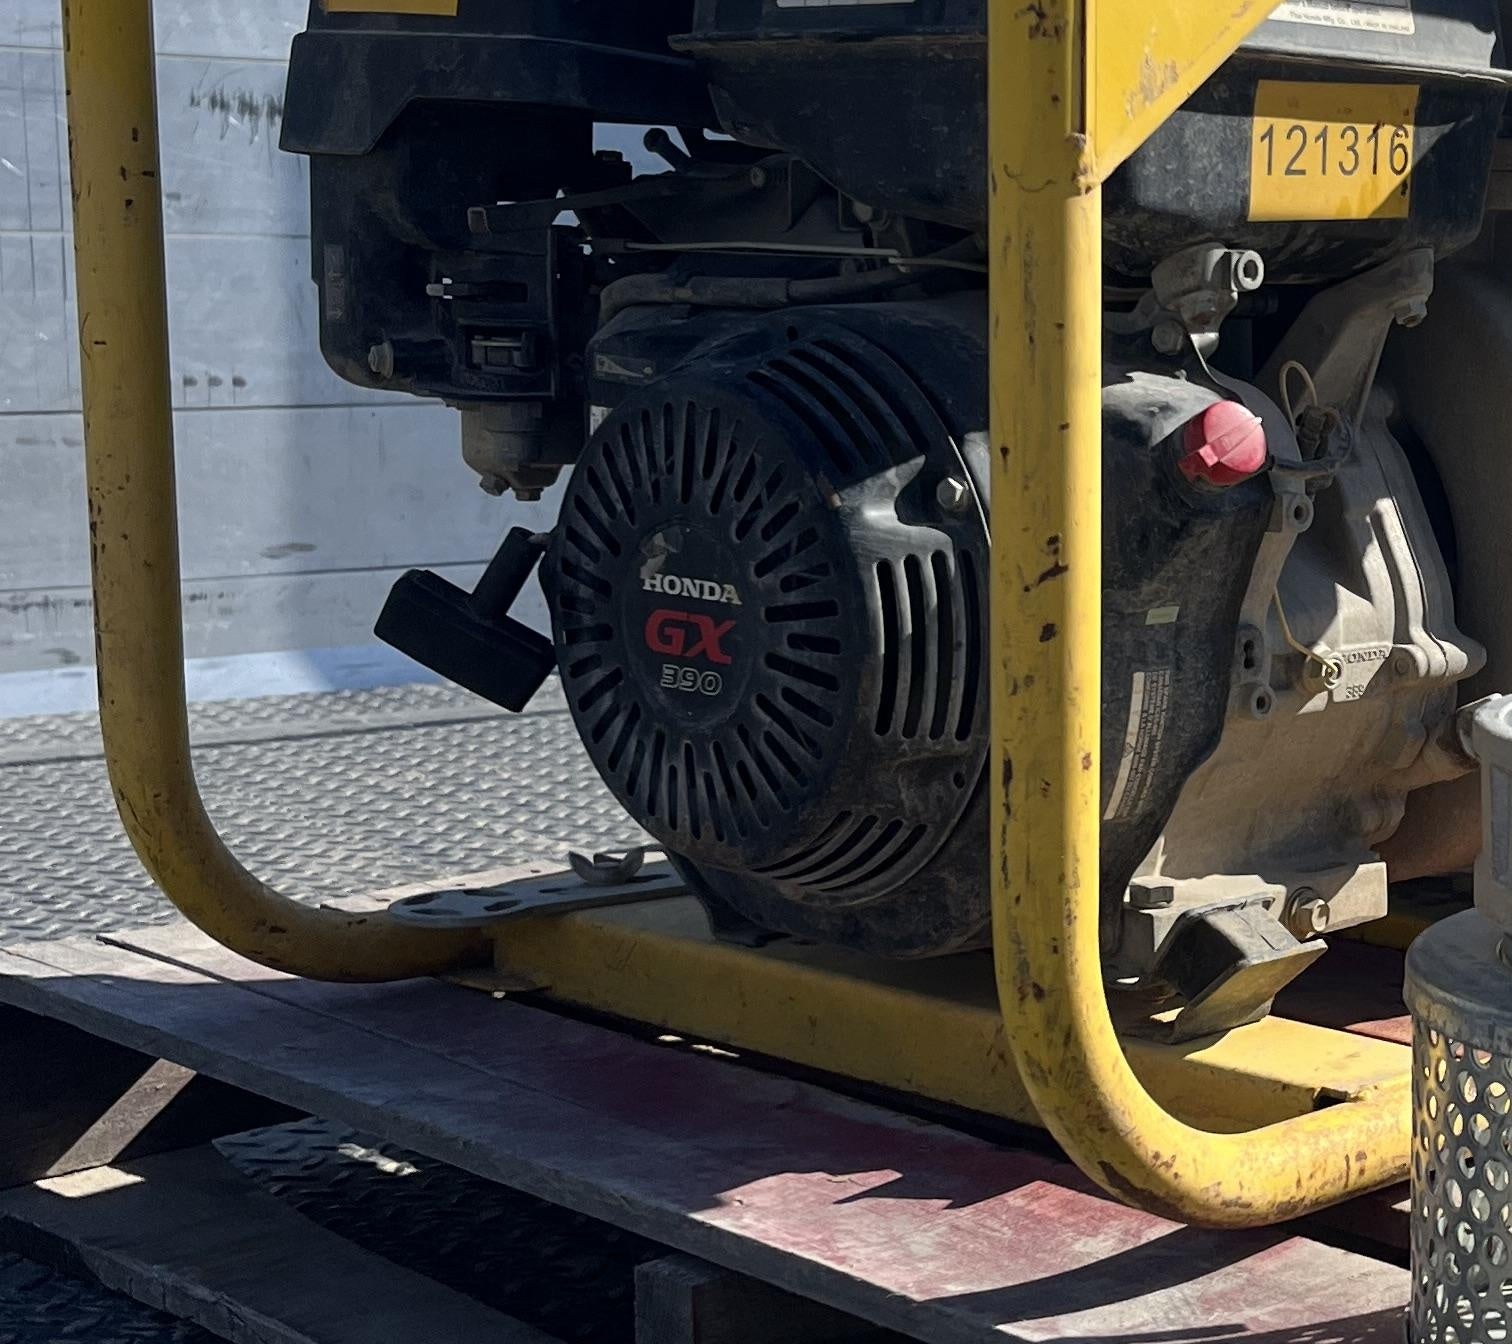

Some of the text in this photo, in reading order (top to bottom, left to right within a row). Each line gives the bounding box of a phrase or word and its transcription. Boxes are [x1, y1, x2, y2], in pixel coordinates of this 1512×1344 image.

[1260, 122, 1409, 176] 121316
[643, 573, 742, 605] HONDA
[645, 609, 737, 665] GX
[660, 664, 723, 696] 390
